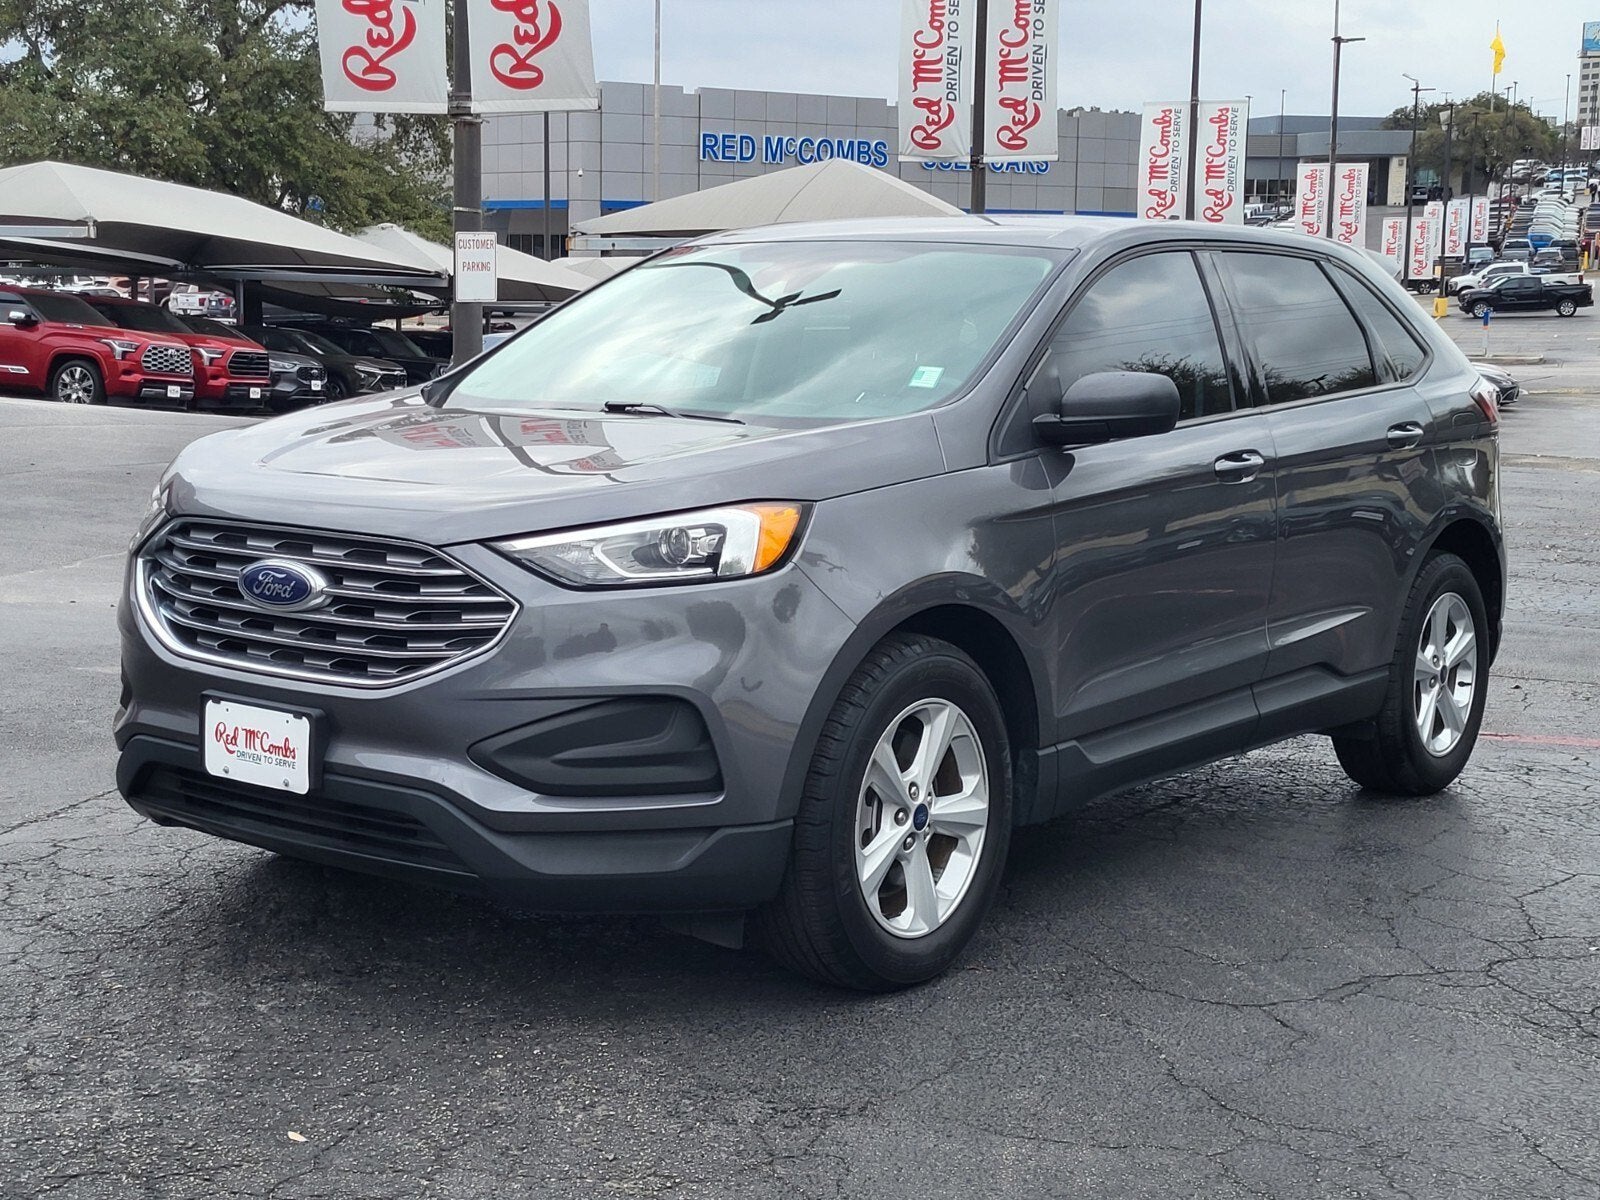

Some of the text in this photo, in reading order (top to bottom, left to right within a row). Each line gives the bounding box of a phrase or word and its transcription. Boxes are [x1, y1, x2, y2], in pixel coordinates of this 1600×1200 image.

[912, 0, 947, 93] McCom
[947, 21, 959, 41] TO
[998, 0, 1032, 93] McCom
[1033, 18, 1045, 39] TO
[946, 45, 959, 102] DRIVEN
[1031, 44, 1044, 101] DRIVEN
[910, 97, 955, 150] Red
[996, 96, 1041, 150] Red
[701, 133, 756, 162] RED
[1145, 108, 1176, 220] Red McCombs
[1170, 108, 1182, 192] DRIVEN TO SERVE
[1202, 107, 1233, 223] Red McCombs
[1227, 107, 1239, 192] DRIVEN TO SERVE
[458, 239, 494, 249] CUSTOMER
[1301, 221, 1320, 236] ed
[1337, 221, 1359, 244] Red
[462, 261, 491, 272] PARKING
[253, 570, 296, 598] Ford
[215, 722, 296, 760] Red McCombs
[236, 750, 297, 769] DRIVEN TO SERVE
